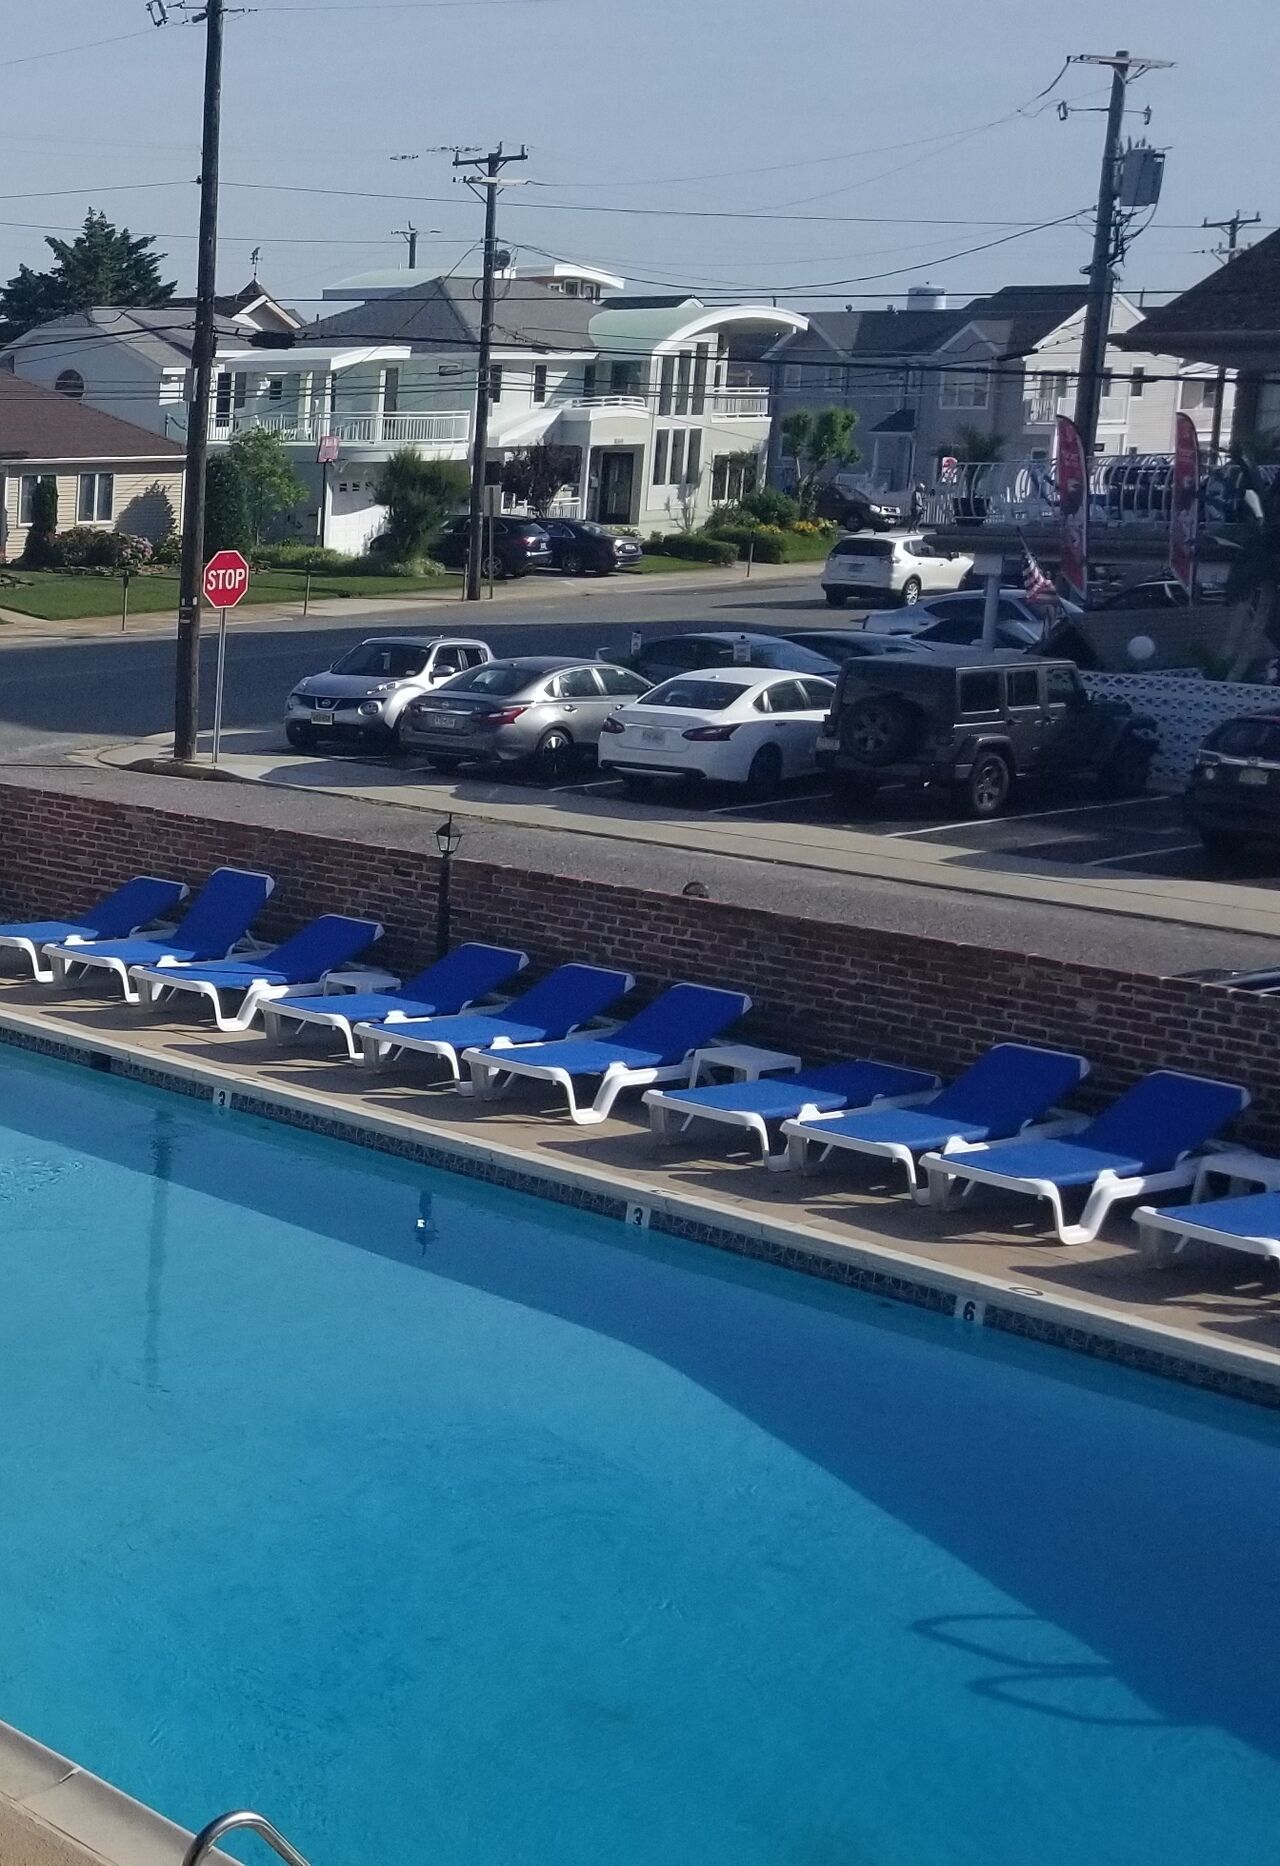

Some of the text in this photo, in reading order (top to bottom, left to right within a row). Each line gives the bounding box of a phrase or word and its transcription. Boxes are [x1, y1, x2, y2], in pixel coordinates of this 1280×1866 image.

[206, 568, 246, 591] STOP
[632, 1206, 643, 1226] 3
[963, 1300, 976, 1321] 6
